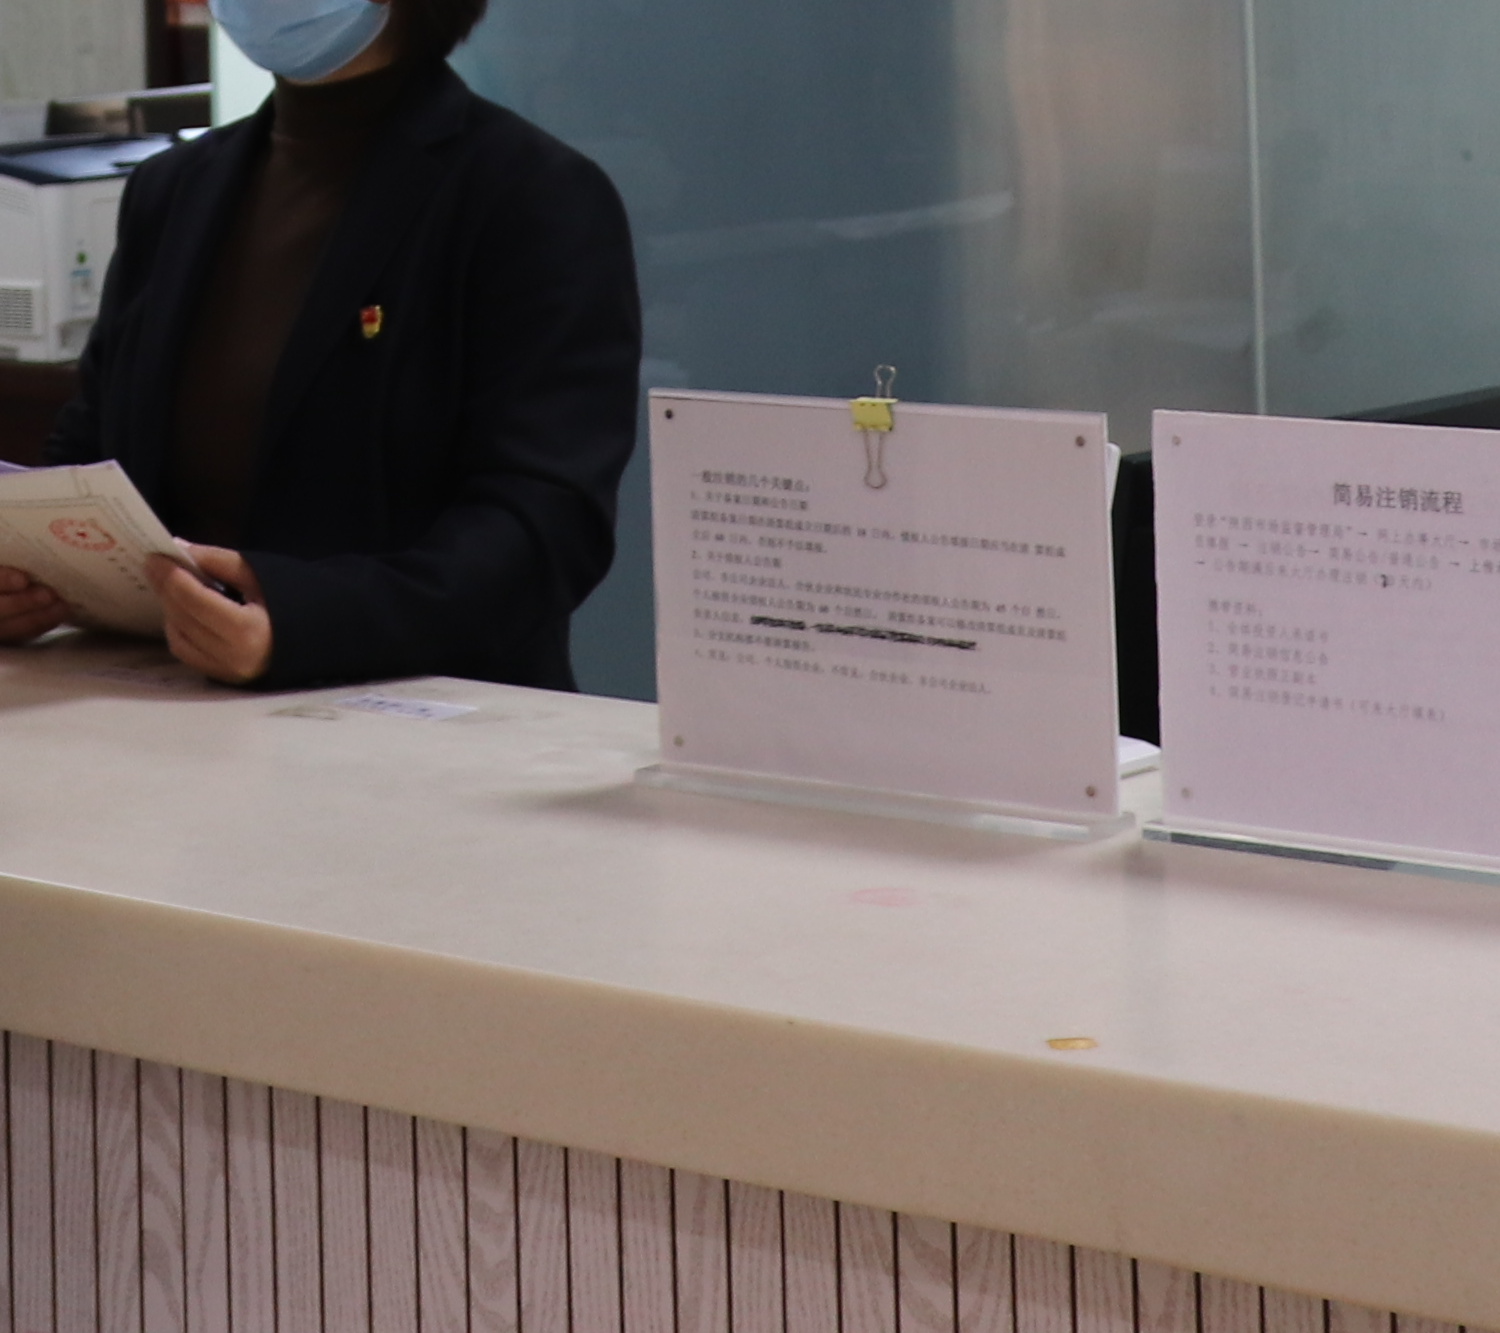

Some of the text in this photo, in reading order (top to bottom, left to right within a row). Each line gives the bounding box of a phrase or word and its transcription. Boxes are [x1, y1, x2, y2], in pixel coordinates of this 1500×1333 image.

[1332, 482, 1464, 515] 简易注销流程
